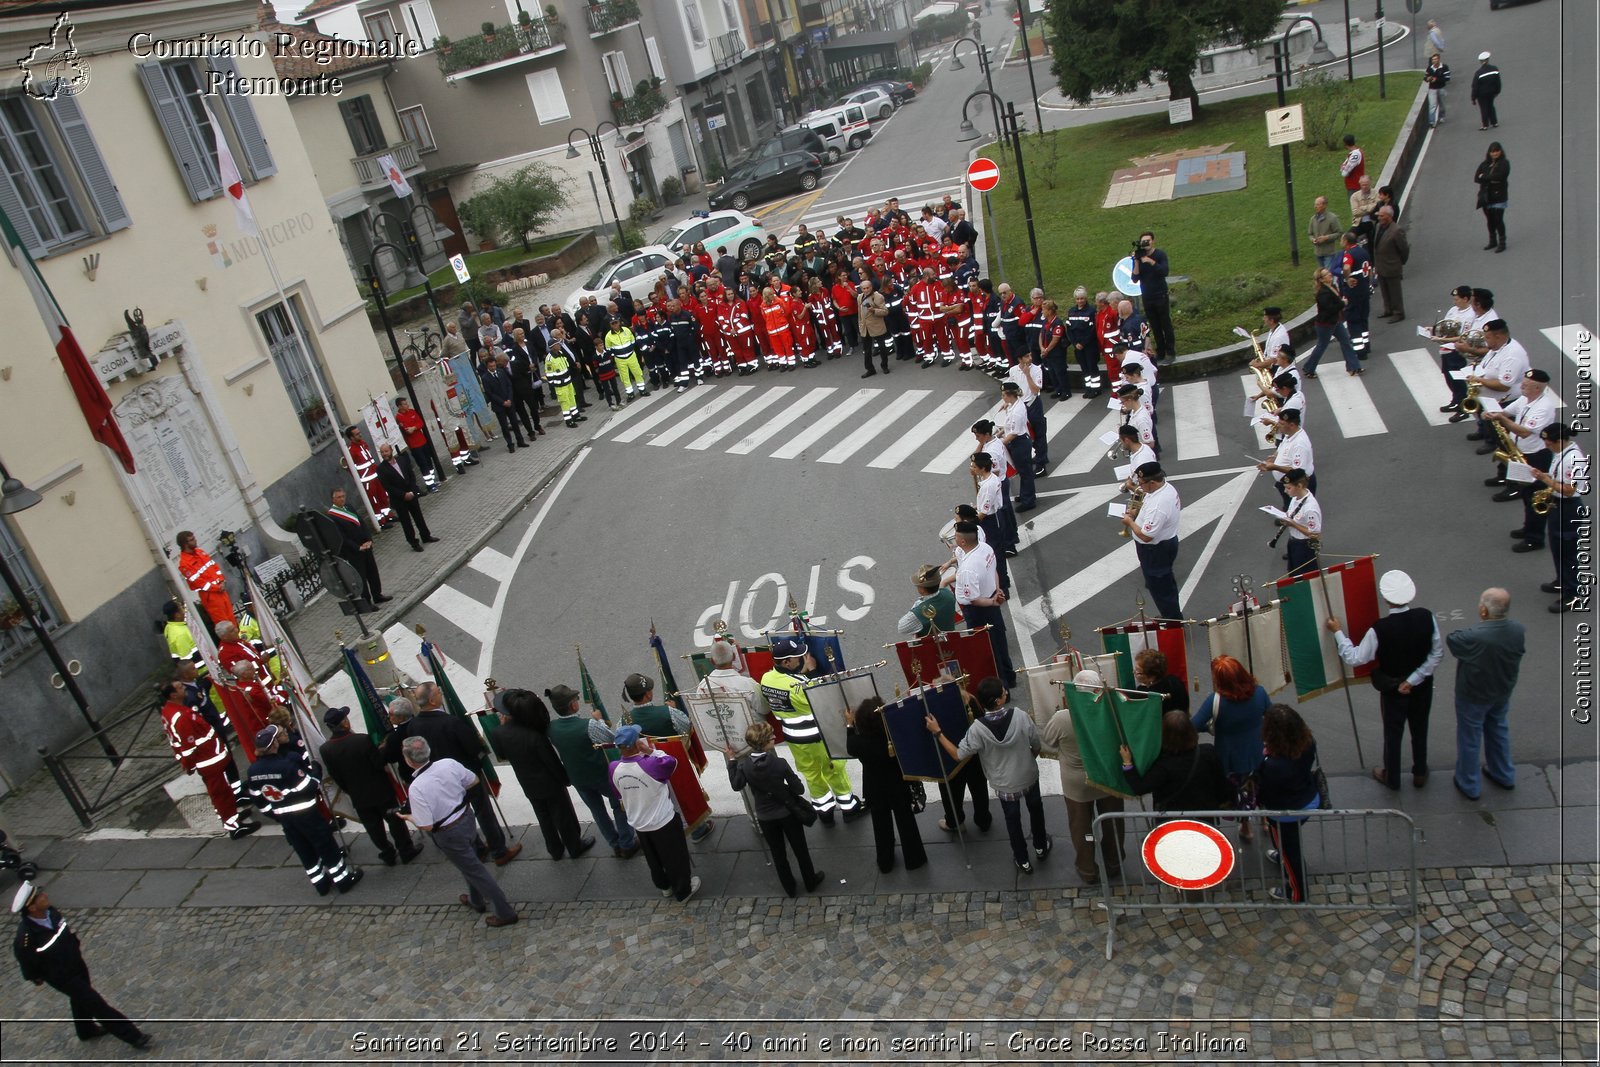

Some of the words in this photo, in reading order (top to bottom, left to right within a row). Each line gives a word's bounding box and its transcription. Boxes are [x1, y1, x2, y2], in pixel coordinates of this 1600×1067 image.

[101, 356, 129, 375] GLORIA
[152, 336, 168, 350] AGLI
[693, 555, 877, 647] STOP
